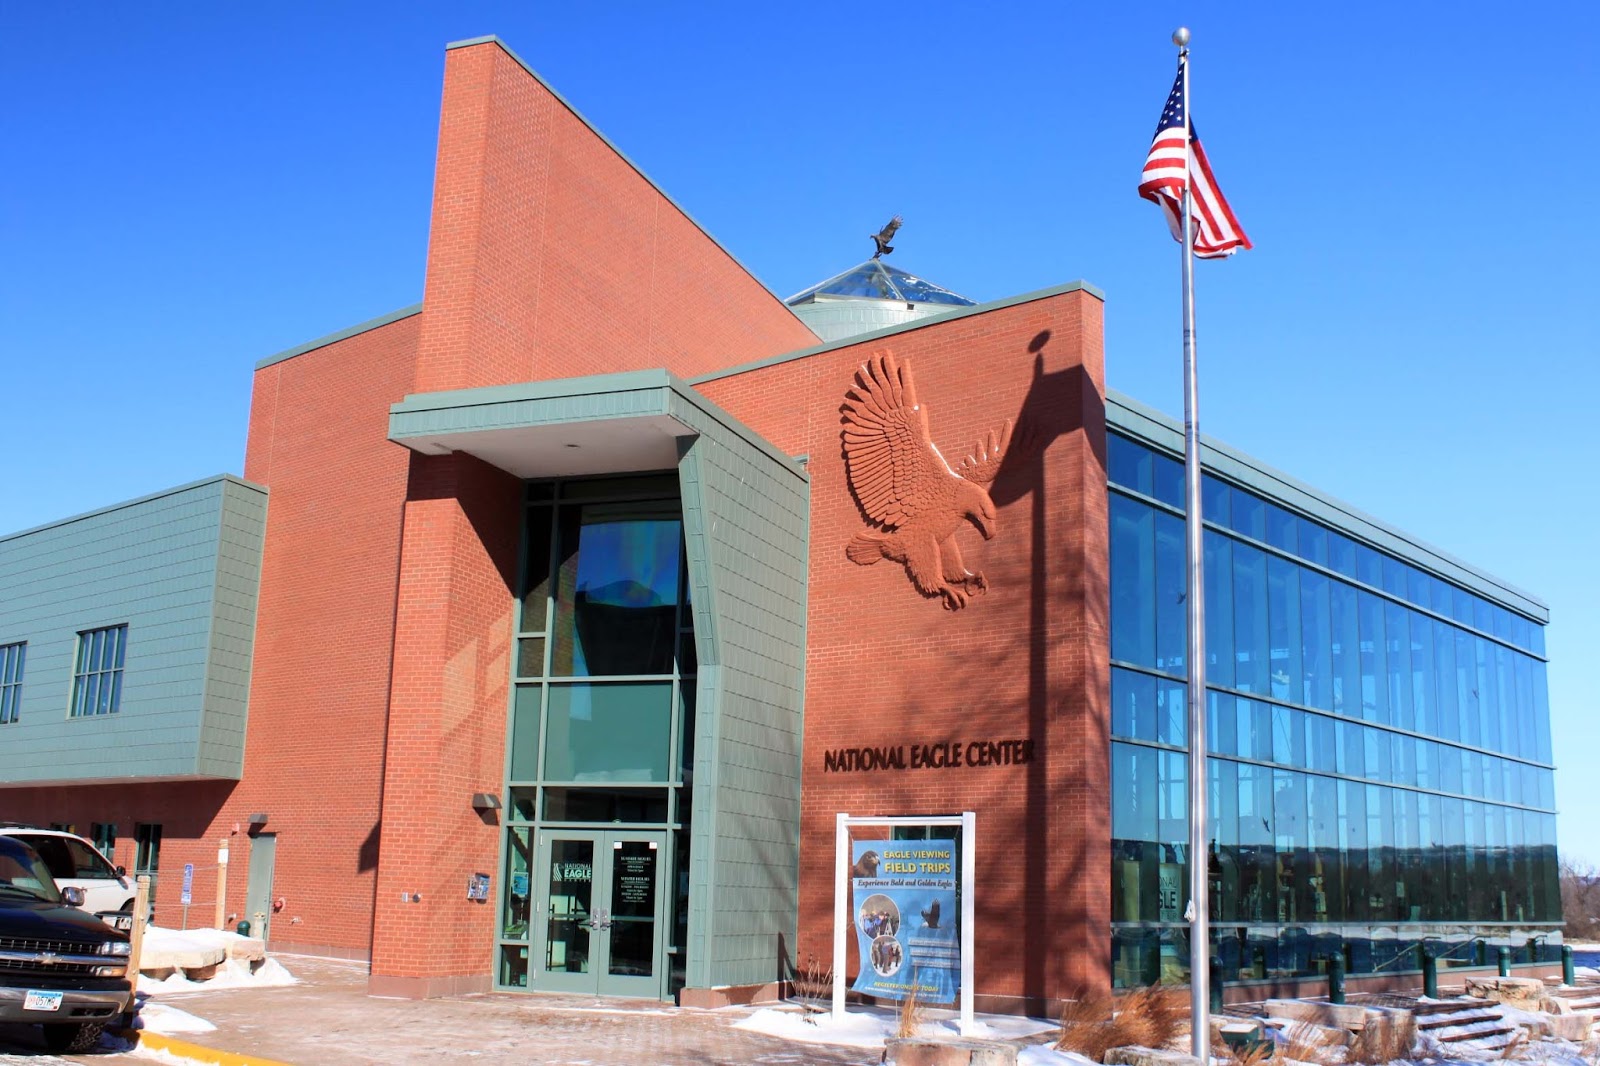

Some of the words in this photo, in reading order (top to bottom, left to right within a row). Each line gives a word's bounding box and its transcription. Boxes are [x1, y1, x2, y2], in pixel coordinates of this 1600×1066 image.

[823, 745, 906, 773] NATIONAL
[910, 742, 963, 769] EAGLE
[965, 739, 1035, 768] CENTER
[883, 850, 911, 859] EAGLE
[912, 850, 950, 859] VIEWING
[884, 862, 917, 873] FIELD
[919, 862, 951, 873] TRIPS
[564, 869, 592, 878] EAGLE
[890, 878, 904, 887] Bald
[905, 879, 917, 887] and
